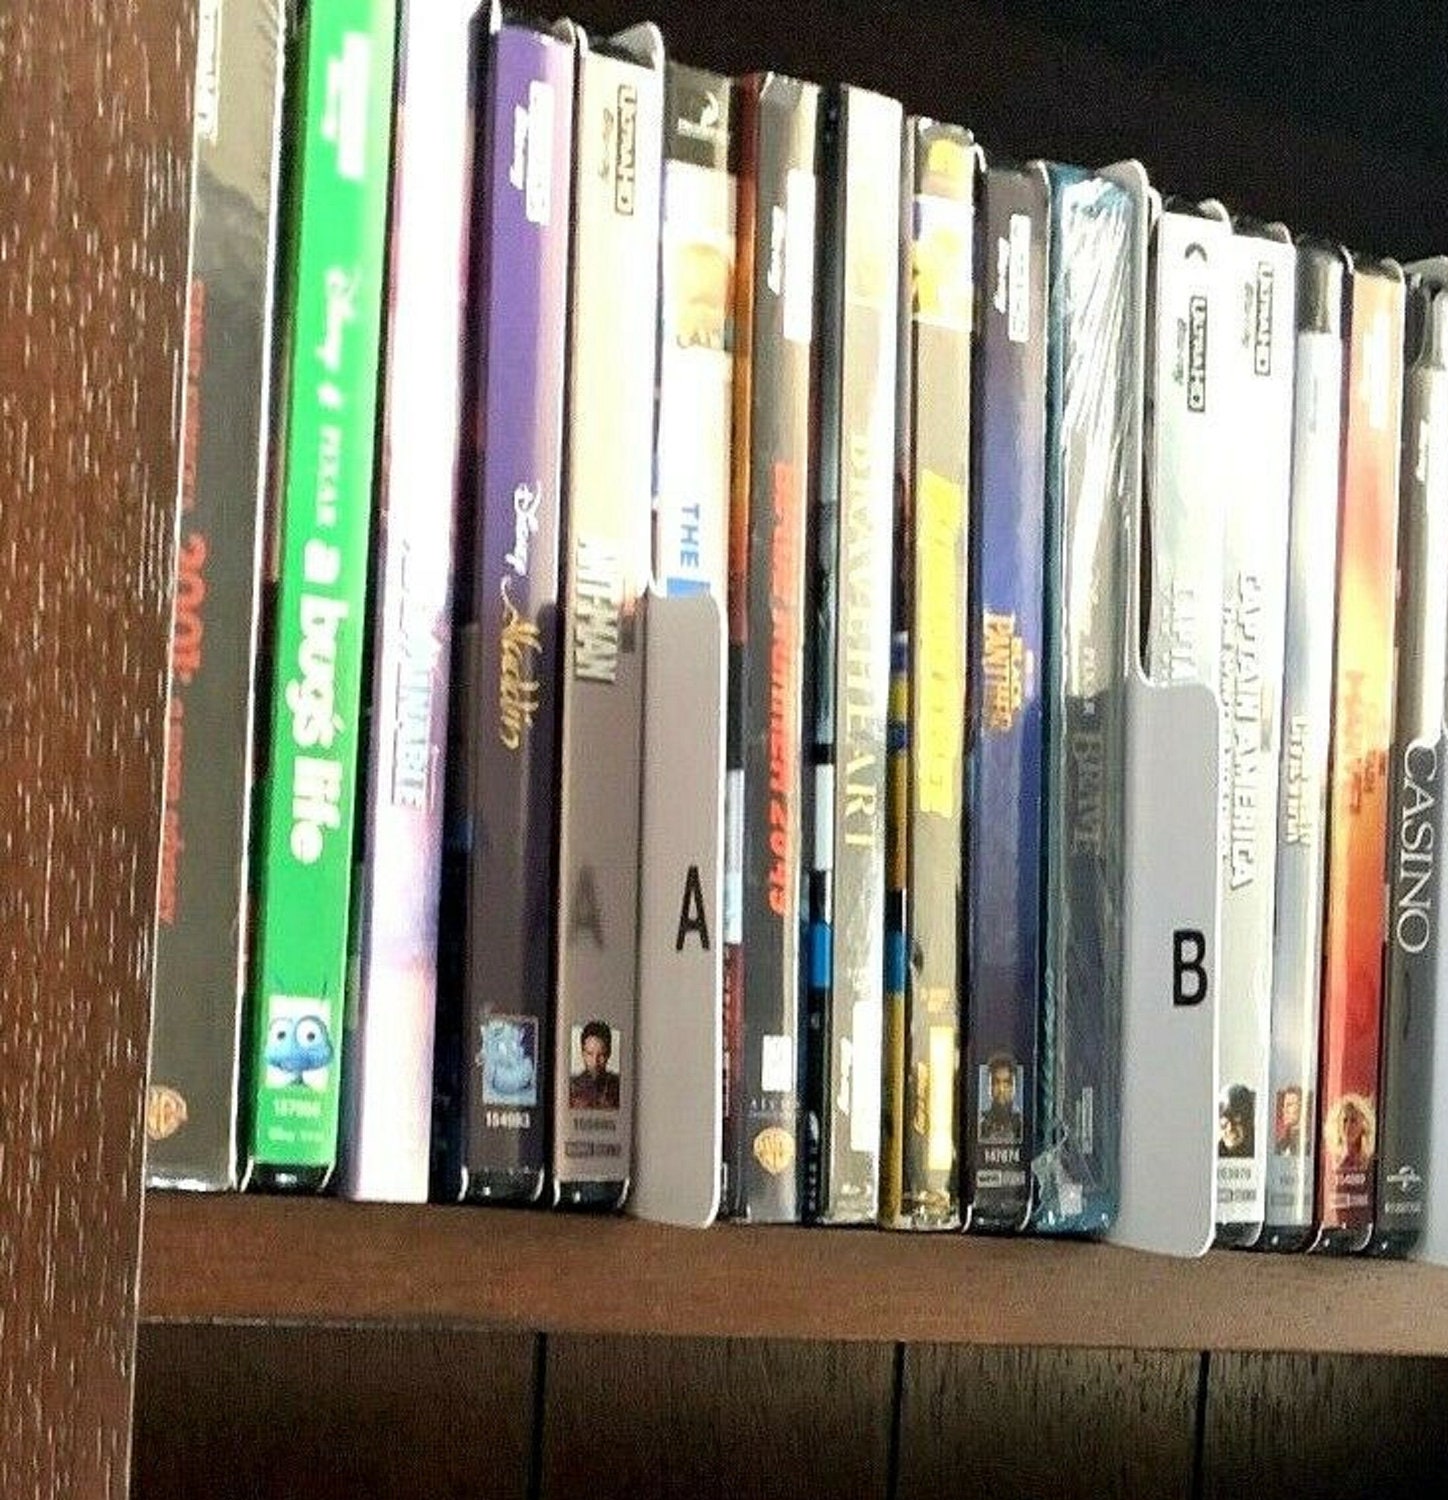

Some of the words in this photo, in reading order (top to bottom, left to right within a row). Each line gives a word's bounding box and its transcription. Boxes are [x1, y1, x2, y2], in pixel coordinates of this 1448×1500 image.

[680, 504, 701, 568] THE
[289, 754, 343, 865] life
[1230, 726, 1258, 892] AMERICA
[1395, 738, 1438, 953] CASINO
[674, 864, 711, 952] A
[1172, 928, 1208, 1007] B
